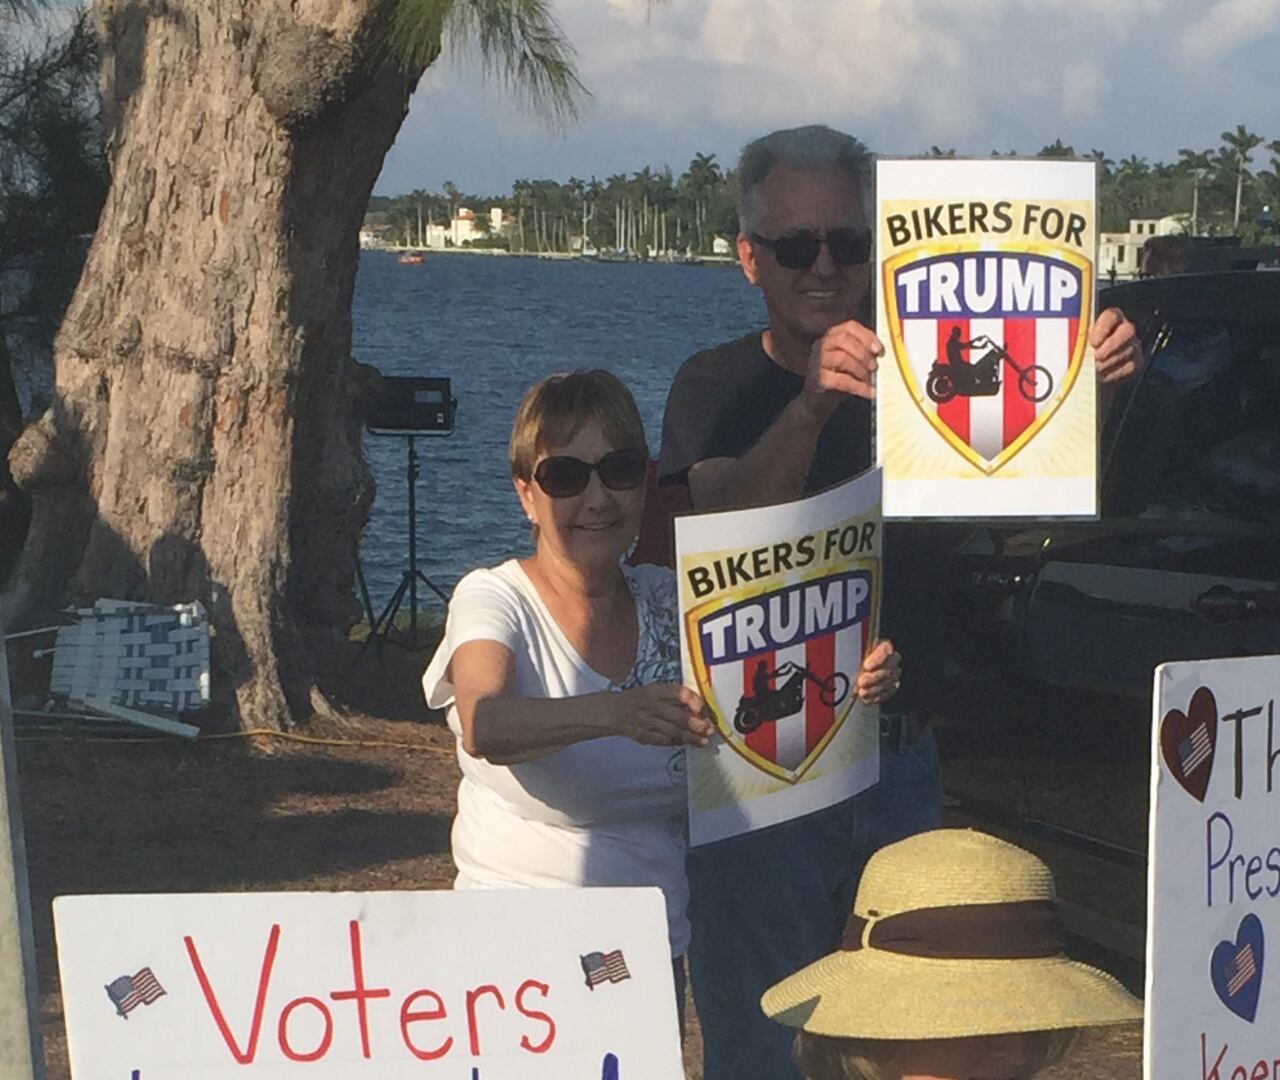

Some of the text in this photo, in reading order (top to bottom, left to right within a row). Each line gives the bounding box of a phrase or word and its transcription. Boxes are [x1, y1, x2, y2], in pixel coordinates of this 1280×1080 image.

[886, 202, 1087, 247] BIKERS FOR
[897, 256, 1079, 313] TRUMP
[687, 520, 877, 599] BIKERS FOR
[701, 577, 869, 660] TRUMP
[184, 920, 557, 1065] Voters
